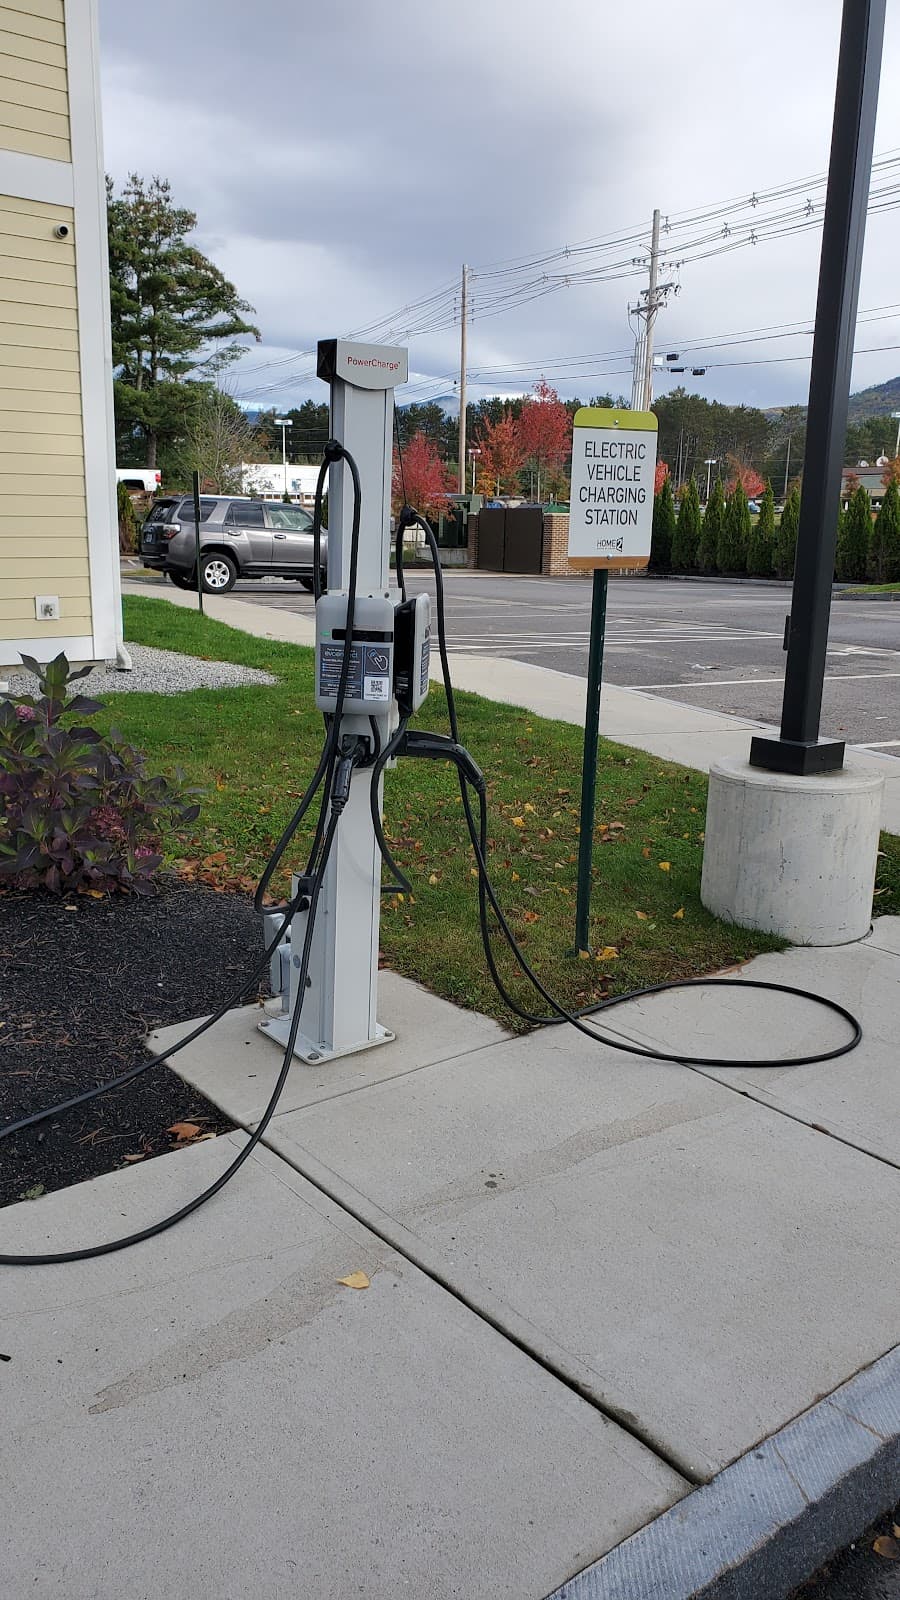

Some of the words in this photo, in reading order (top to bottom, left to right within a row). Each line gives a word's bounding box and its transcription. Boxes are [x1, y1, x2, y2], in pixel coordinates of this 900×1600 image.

[585, 441, 646, 459] ELECTRIC
[587, 464, 641, 481] VEHICLE
[579, 486, 646, 503] CHARGING
[585, 508, 638, 525] STATION
